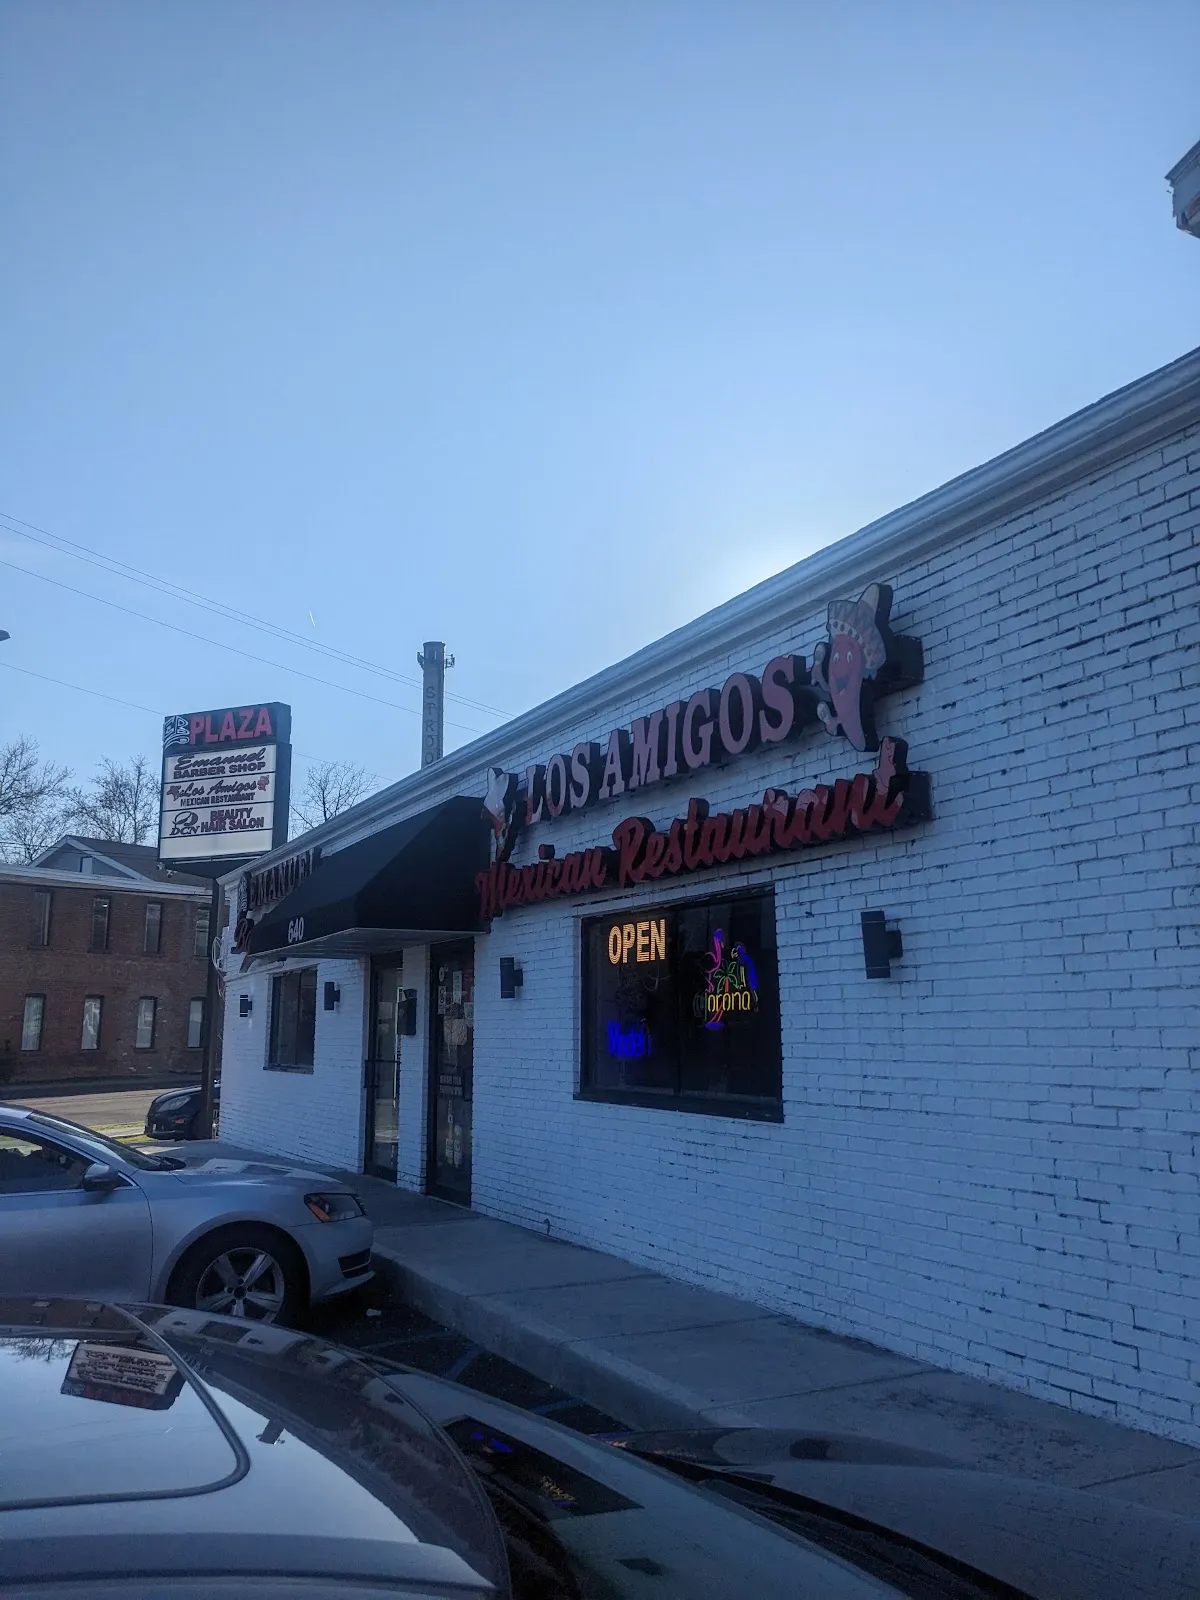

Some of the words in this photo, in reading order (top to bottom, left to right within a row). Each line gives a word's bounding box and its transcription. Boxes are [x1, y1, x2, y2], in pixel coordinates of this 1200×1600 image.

[189, 707, 272, 745] PLAZA
[525, 742, 591, 826] LOS
[598, 656, 796, 801] AMIGOS
[174, 747, 265, 770] Emanuel
[173, 766, 225, 779] BARBER
[229, 762, 265, 773] SHOP
[178, 782, 204, 797] Los
[207, 780, 257, 796] Amigos
[180, 796, 210, 807] MEXICAN
[211, 792, 255, 804] RESTAURANT
[200, 819, 226, 832] HAIR
[228, 817, 264, 830] SALON
[210, 807, 253, 821] BEAUTY
[475, 844, 605, 917] Mexican
[613, 737, 905, 887] Restaurant
[286, 914, 305, 943] 640
[608, 919, 667, 965] OPEN
